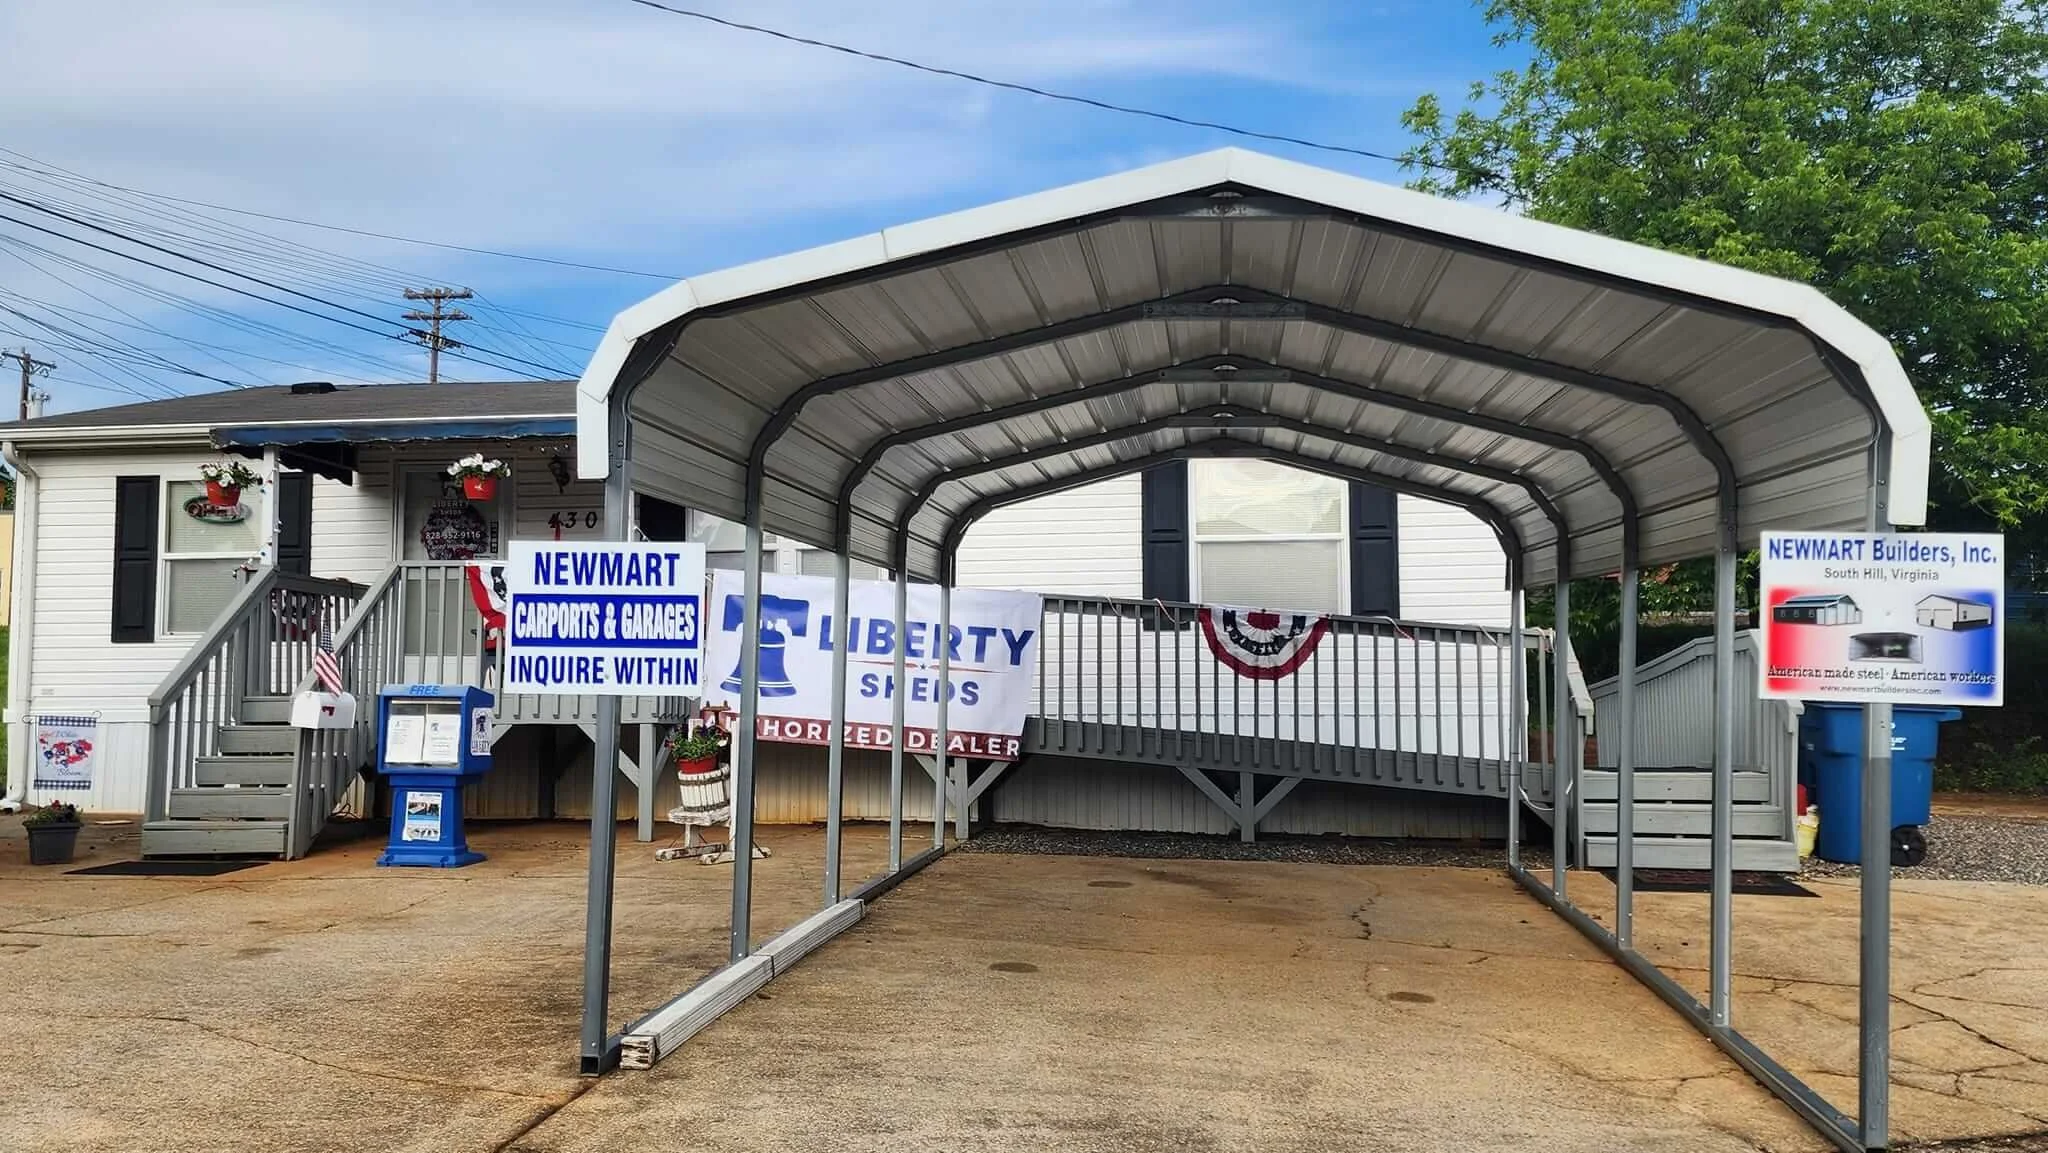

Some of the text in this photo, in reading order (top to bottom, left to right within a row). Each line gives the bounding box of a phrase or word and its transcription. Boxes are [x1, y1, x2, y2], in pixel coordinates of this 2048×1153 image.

[548, 511, 598, 528] 430
[1768, 538, 1997, 567] NEWMART Builders, Inc.
[534, 552, 680, 586] NEWMART
[1824, 567, 1939, 583] South Hill, Virginia
[515, 601, 695, 641] CARPORTS & GARAGES
[818, 615, 1035, 666] LIBERTY
[510, 655, 698, 686] INQUIRE WITHIN
[1767, 665, 1997, 685] American made steel American workers
[409, 685, 440, 695] FREE
